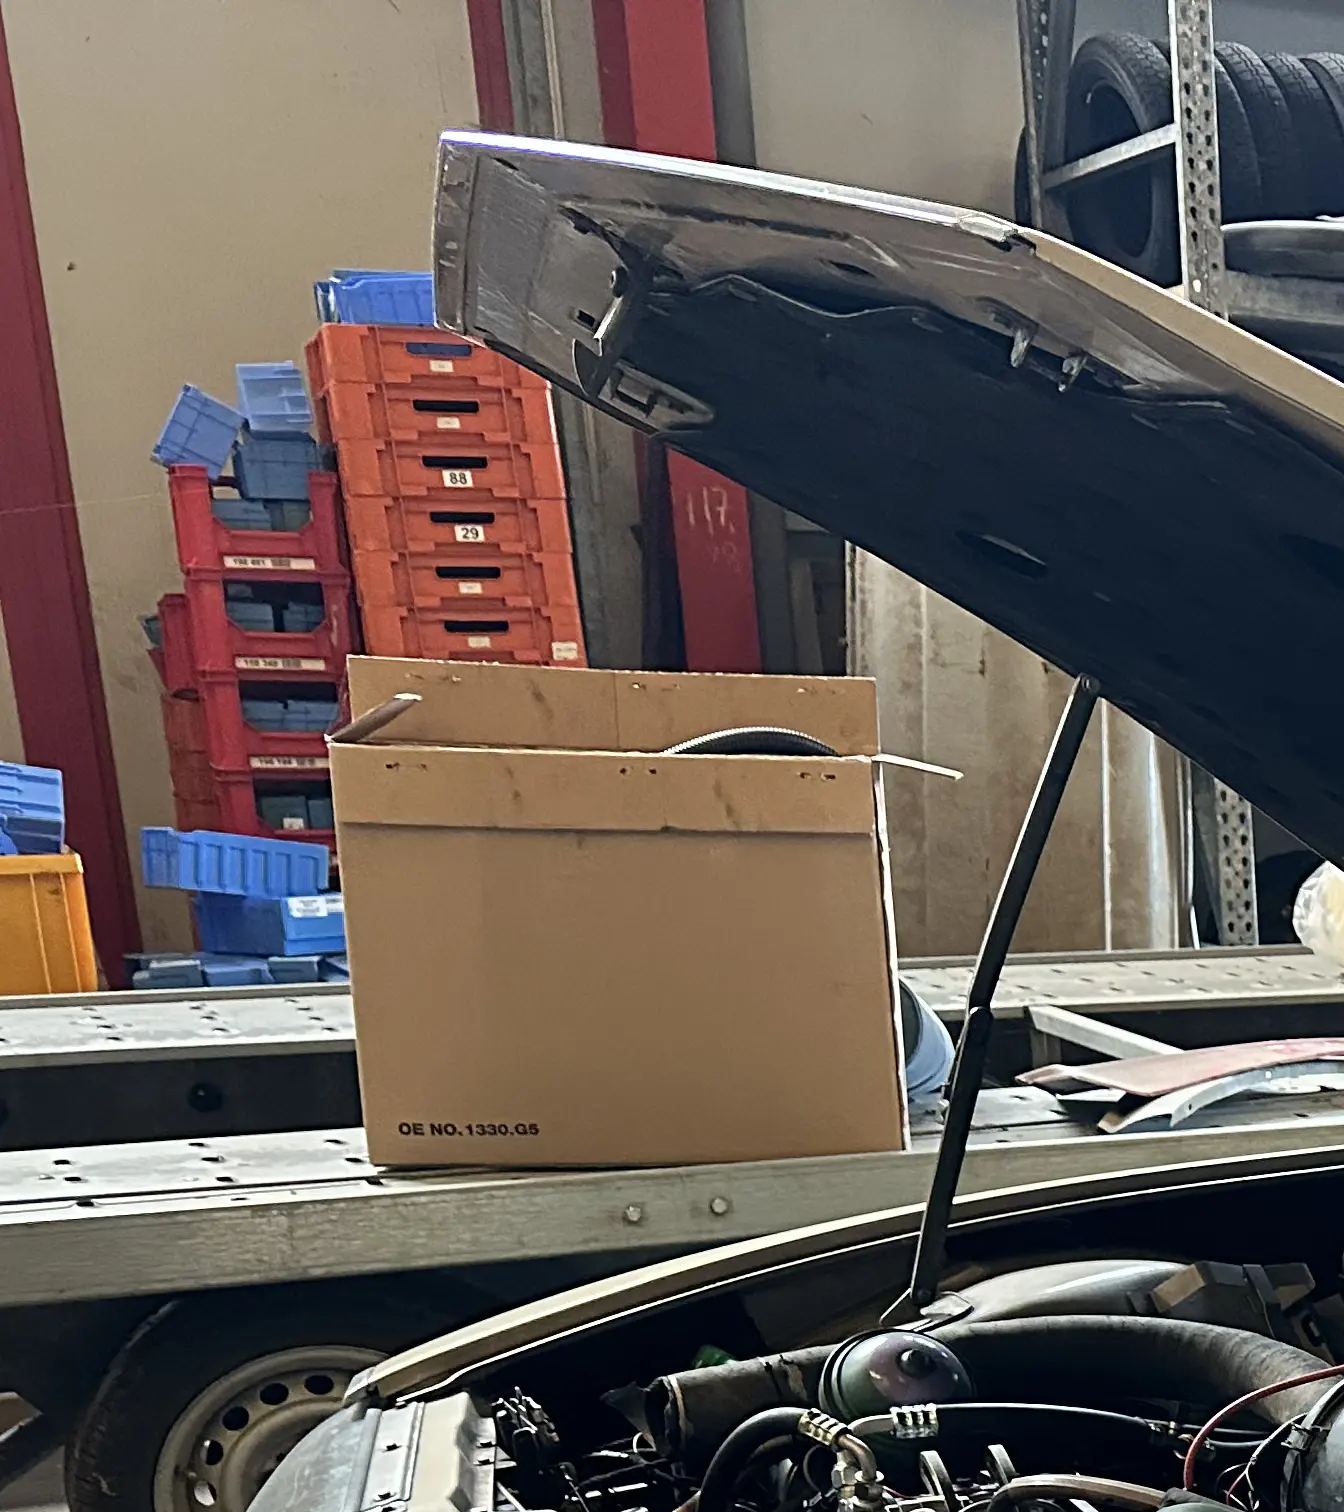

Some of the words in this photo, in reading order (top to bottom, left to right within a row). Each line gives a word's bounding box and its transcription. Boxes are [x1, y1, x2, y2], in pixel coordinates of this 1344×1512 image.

[449, 471, 468, 485] 88
[460, 527, 480, 540] 29
[398, 1121, 425, 1136] OE
